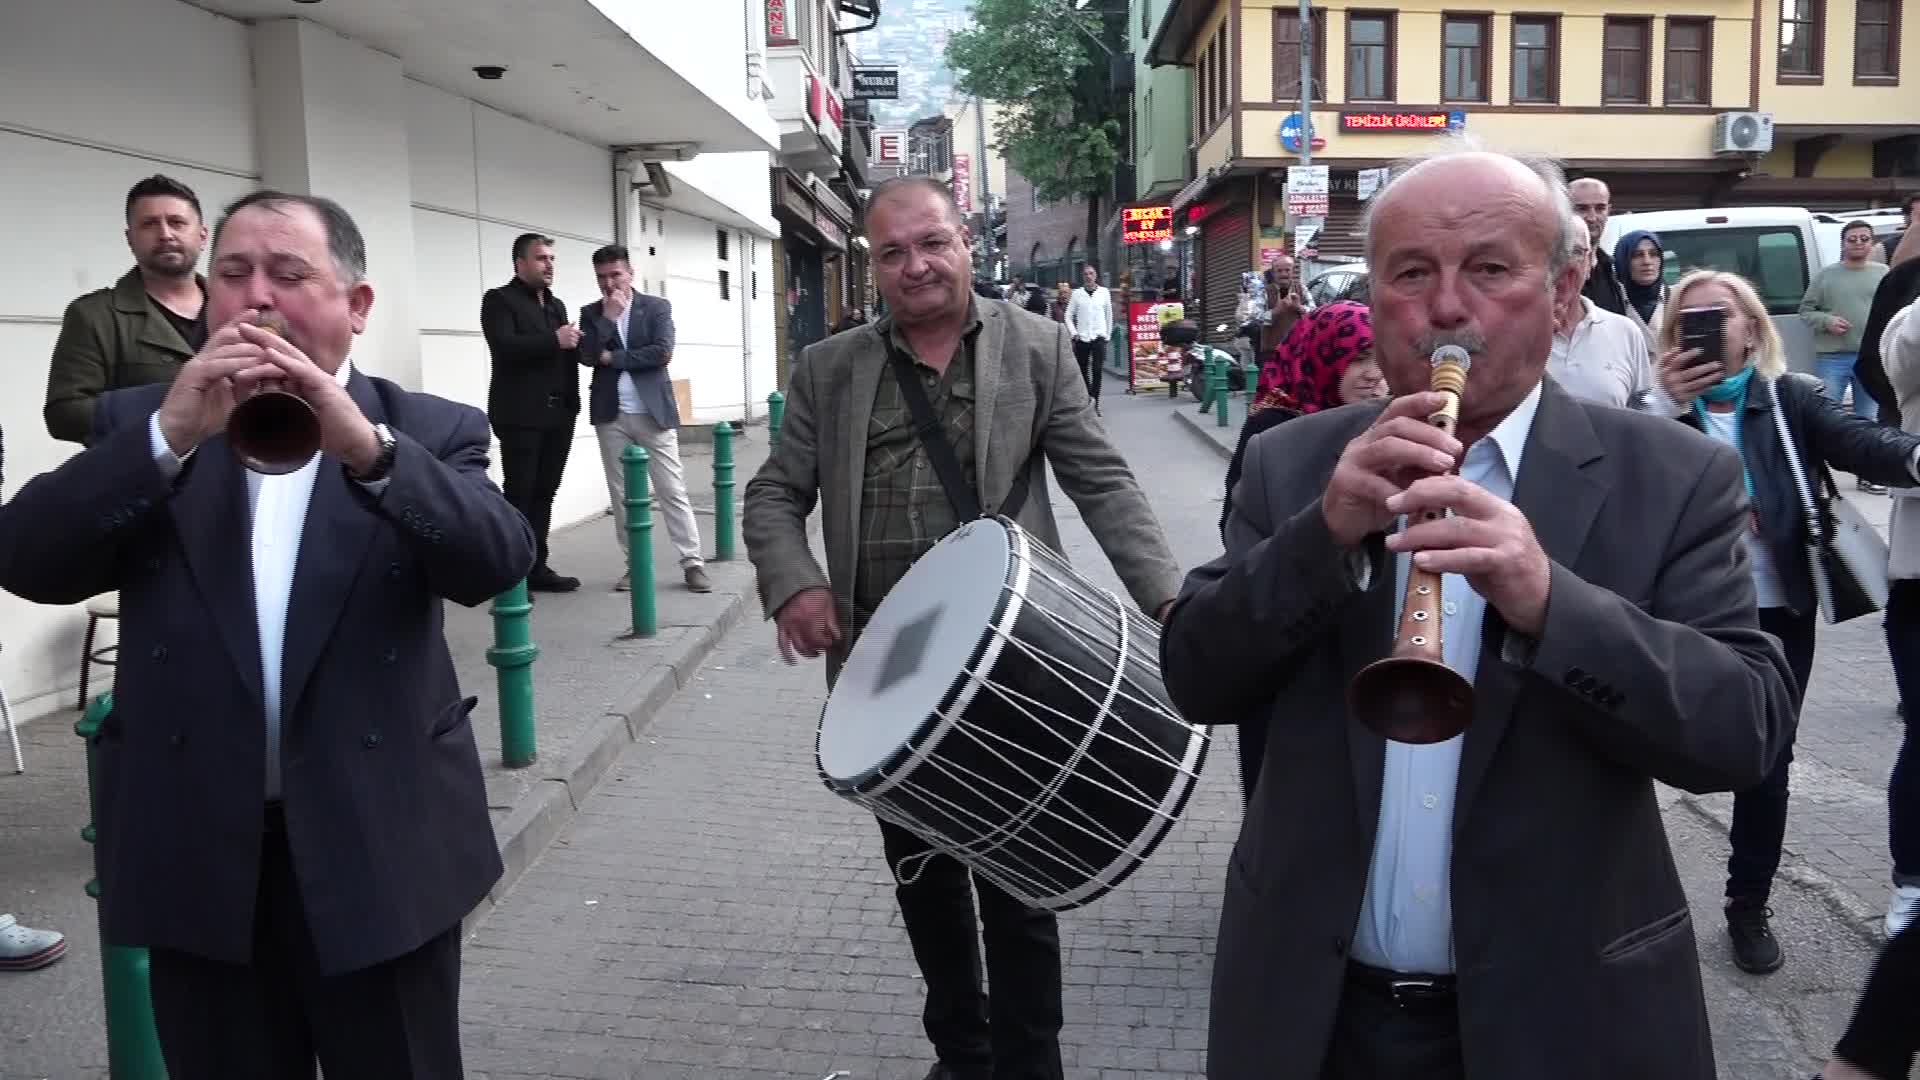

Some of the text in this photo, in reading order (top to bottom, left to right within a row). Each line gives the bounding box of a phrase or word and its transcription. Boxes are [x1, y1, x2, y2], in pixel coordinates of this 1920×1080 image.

[1344, 114, 1393, 128] TEMİZLİK
[1394, 113, 1447, 128] ÜRÜNLERİ
[880, 136, 899, 161] E
[1131, 208, 1163, 220] SICAK
[1140, 219, 1155, 230] EV
